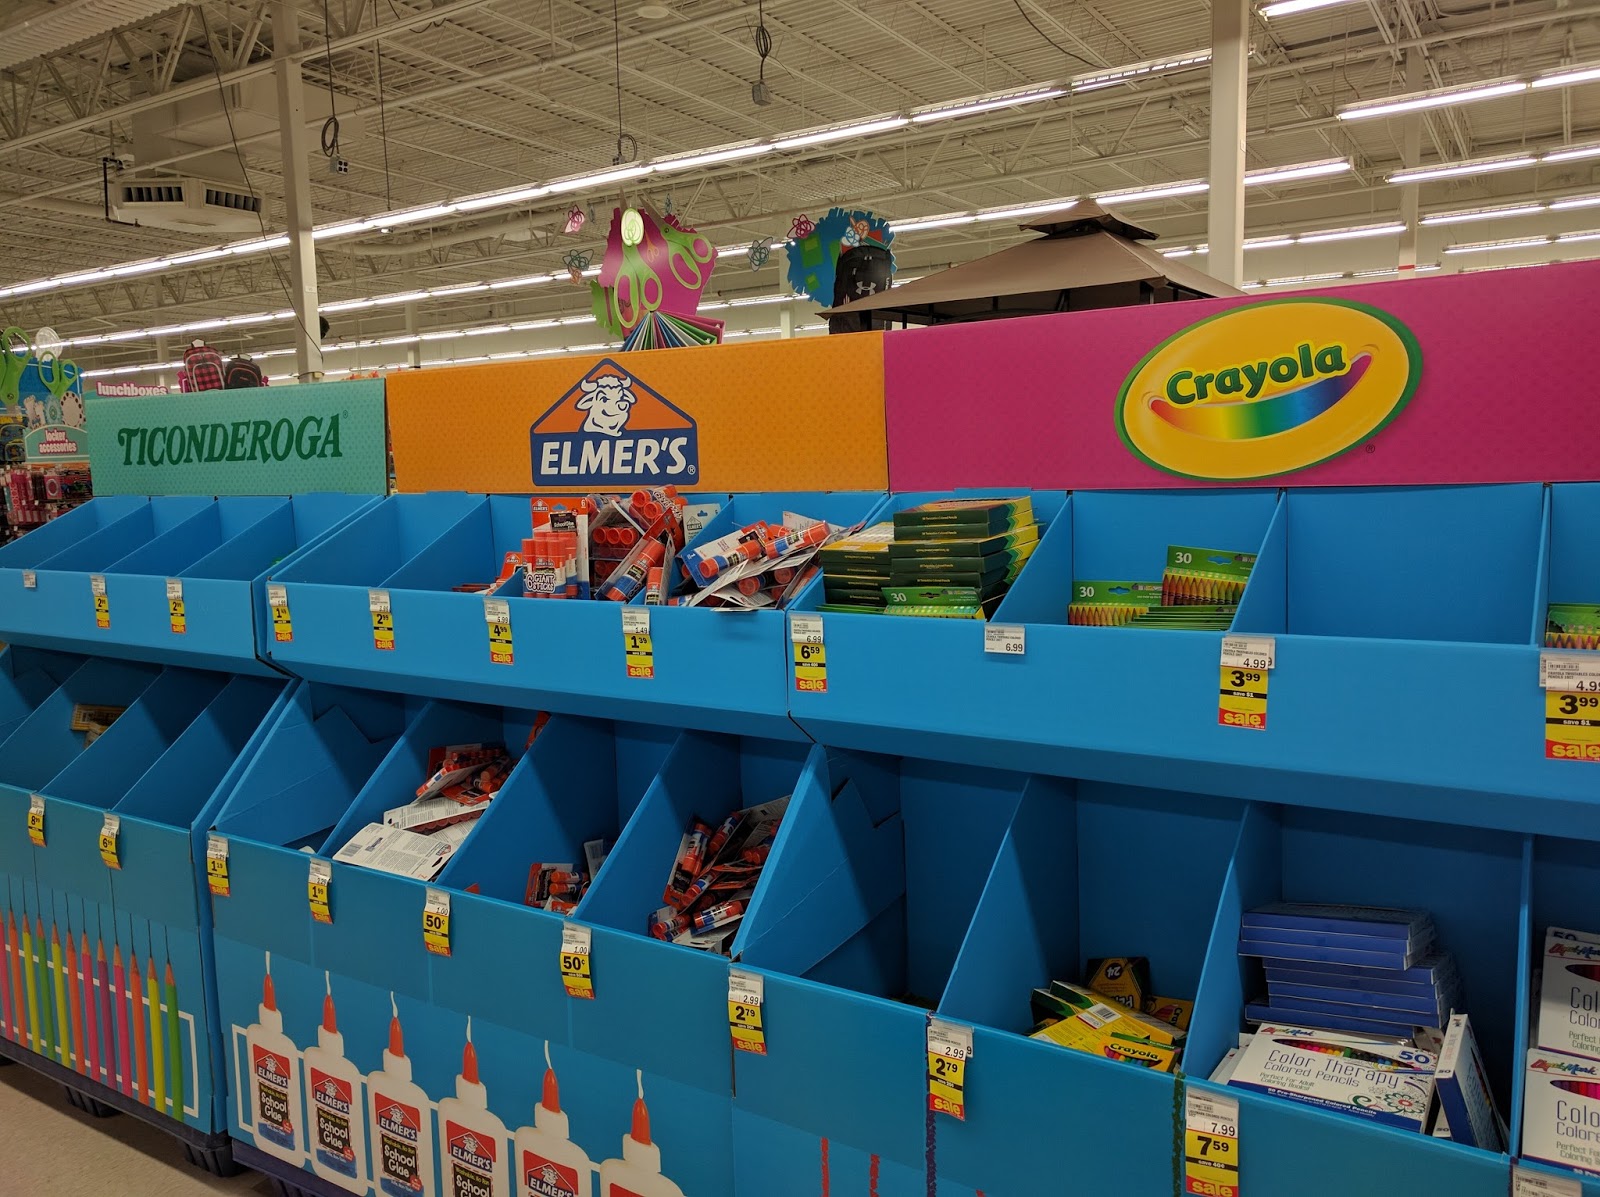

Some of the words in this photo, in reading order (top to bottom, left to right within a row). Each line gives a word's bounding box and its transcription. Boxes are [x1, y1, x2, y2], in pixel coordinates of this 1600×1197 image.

[1167, 343, 1347, 404] Crayola
[97, 382, 168, 396] lunchboxes
[45, 430, 66, 442] locker
[118, 413, 343, 467] TICONDEROGA
[39, 440, 77, 453] accessories
[540, 436, 688, 475] ELMER'S
[1175, 552, 1192, 564] 30
[526, 575, 533, 590] 6
[533, 573, 555, 583] GIANT
[890, 591, 907, 602] 30
[1079, 586, 1095, 598] 30
[376, 640, 393, 649] sale
[806, 635, 822, 643] 6.99
[1005, 643, 1023, 652] 6.99
[493, 653, 512, 663] sale
[1243, 658, 1267, 669] 4.99
[630, 666, 651, 676] sale
[799, 679, 824, 690] sale
[1223, 711, 1262, 725] sale
[1580, 719, 1591, 727] $1
[1552, 743, 1600, 758] sale
[573, 946, 588, 955] 1.00
[1107, 966, 1121, 978] 24
[568, 986, 591, 998] sale
[743, 994, 759, 1005] 2.99
[1568, 1030, 1597, 1043] Perfect
[737, 1040, 763, 1052] sale
[945, 1046, 965, 1059] 2.99
[1110, 1042, 1159, 1060] Crayola
[1399, 1050, 1430, 1065] 50
[258, 1067, 288, 1087] ELMER'S
[1264, 1061, 1312, 1078] Colored
[1315, 1070, 1360, 1088] Pencils
[1268, 1050, 1316, 1068] Color
[1325, 1058, 1400, 1090] Therapy
[261, 1092, 287, 1113] School
[316, 1091, 349, 1112] ELMER'S
[934, 1097, 961, 1115] sale
[264, 1105, 283, 1122] Glue
[320, 1117, 349, 1140] School
[381, 1117, 416, 1140] ELMER'S
[1211, 1122, 1236, 1137] 7.99
[323, 1131, 343, 1149] Glue
[1556, 1140, 1586, 1152] Perfect
[384, 1144, 416, 1168] School
[452, 1146, 491, 1170] ELMER'S
[388, 1160, 410, 1177] Glue
[456, 1175, 490, 1197] School
[530, 1177, 574, 1197] ELMER'S
[1191, 1180, 1233, 1197] sale
